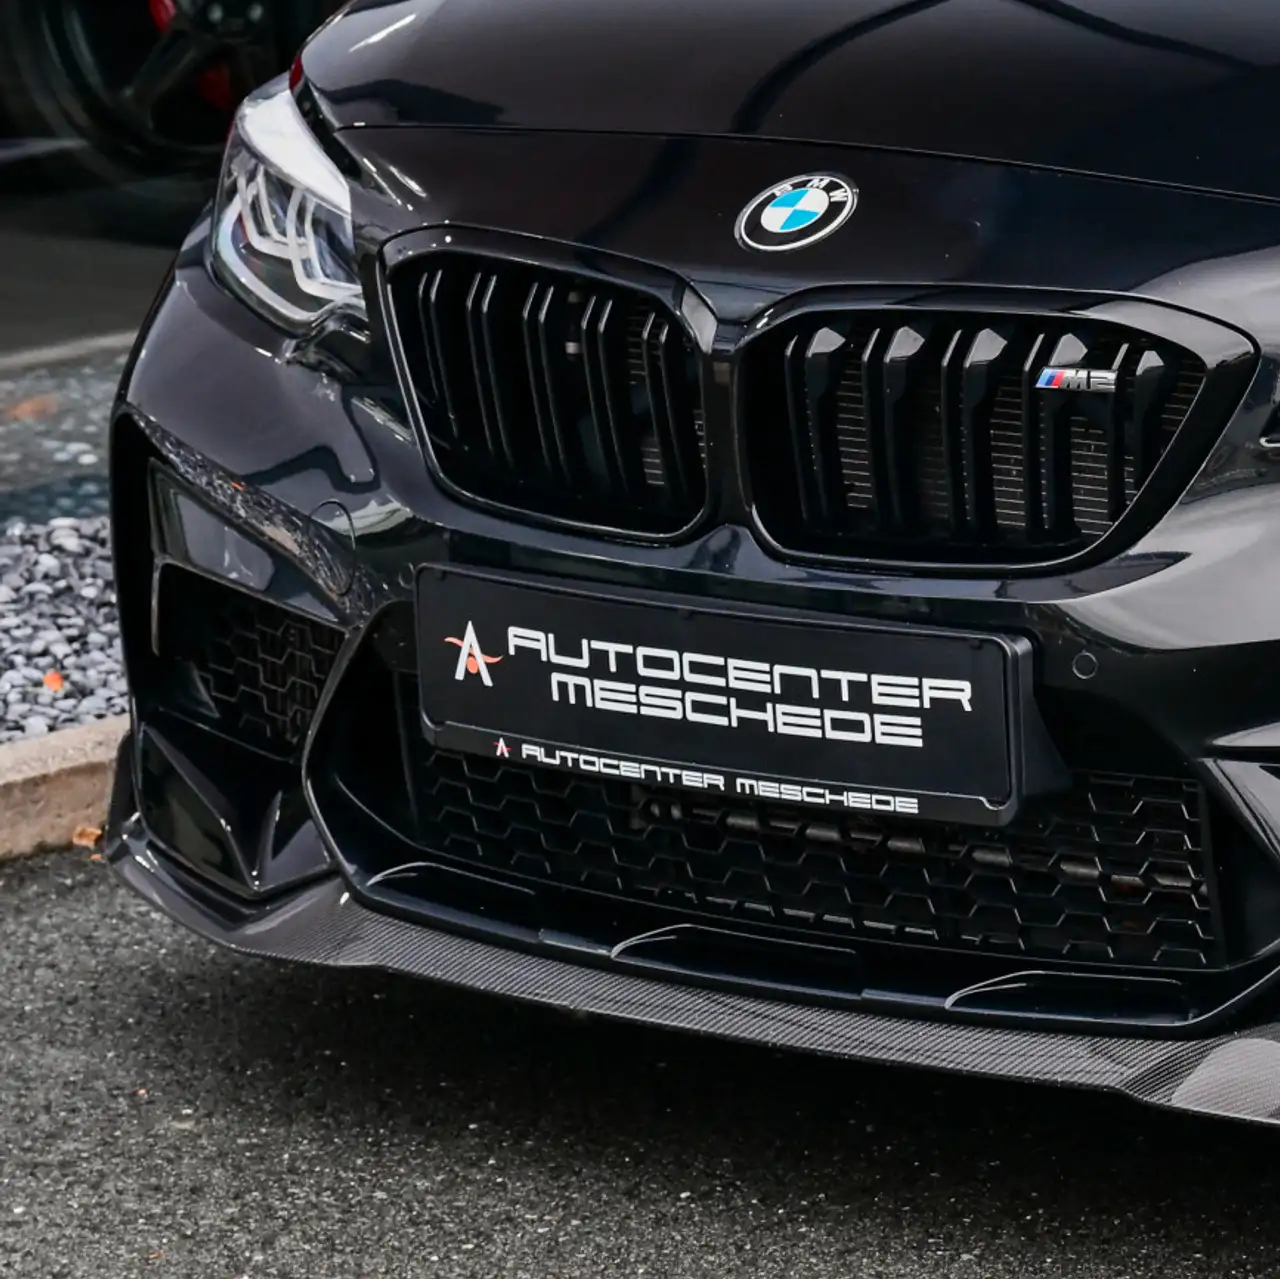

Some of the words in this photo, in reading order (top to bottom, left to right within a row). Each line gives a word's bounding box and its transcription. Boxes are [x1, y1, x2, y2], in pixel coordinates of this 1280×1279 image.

[774, 177, 850, 202] BMW
[1057, 369, 1117, 392] M2
[507, 625, 973, 712] AUTOCENTER
[550, 671, 923, 748] MESCHEDE
[520, 743, 725, 791] AUTOCENTER
[735, 777, 919, 814] MESCHEDE
